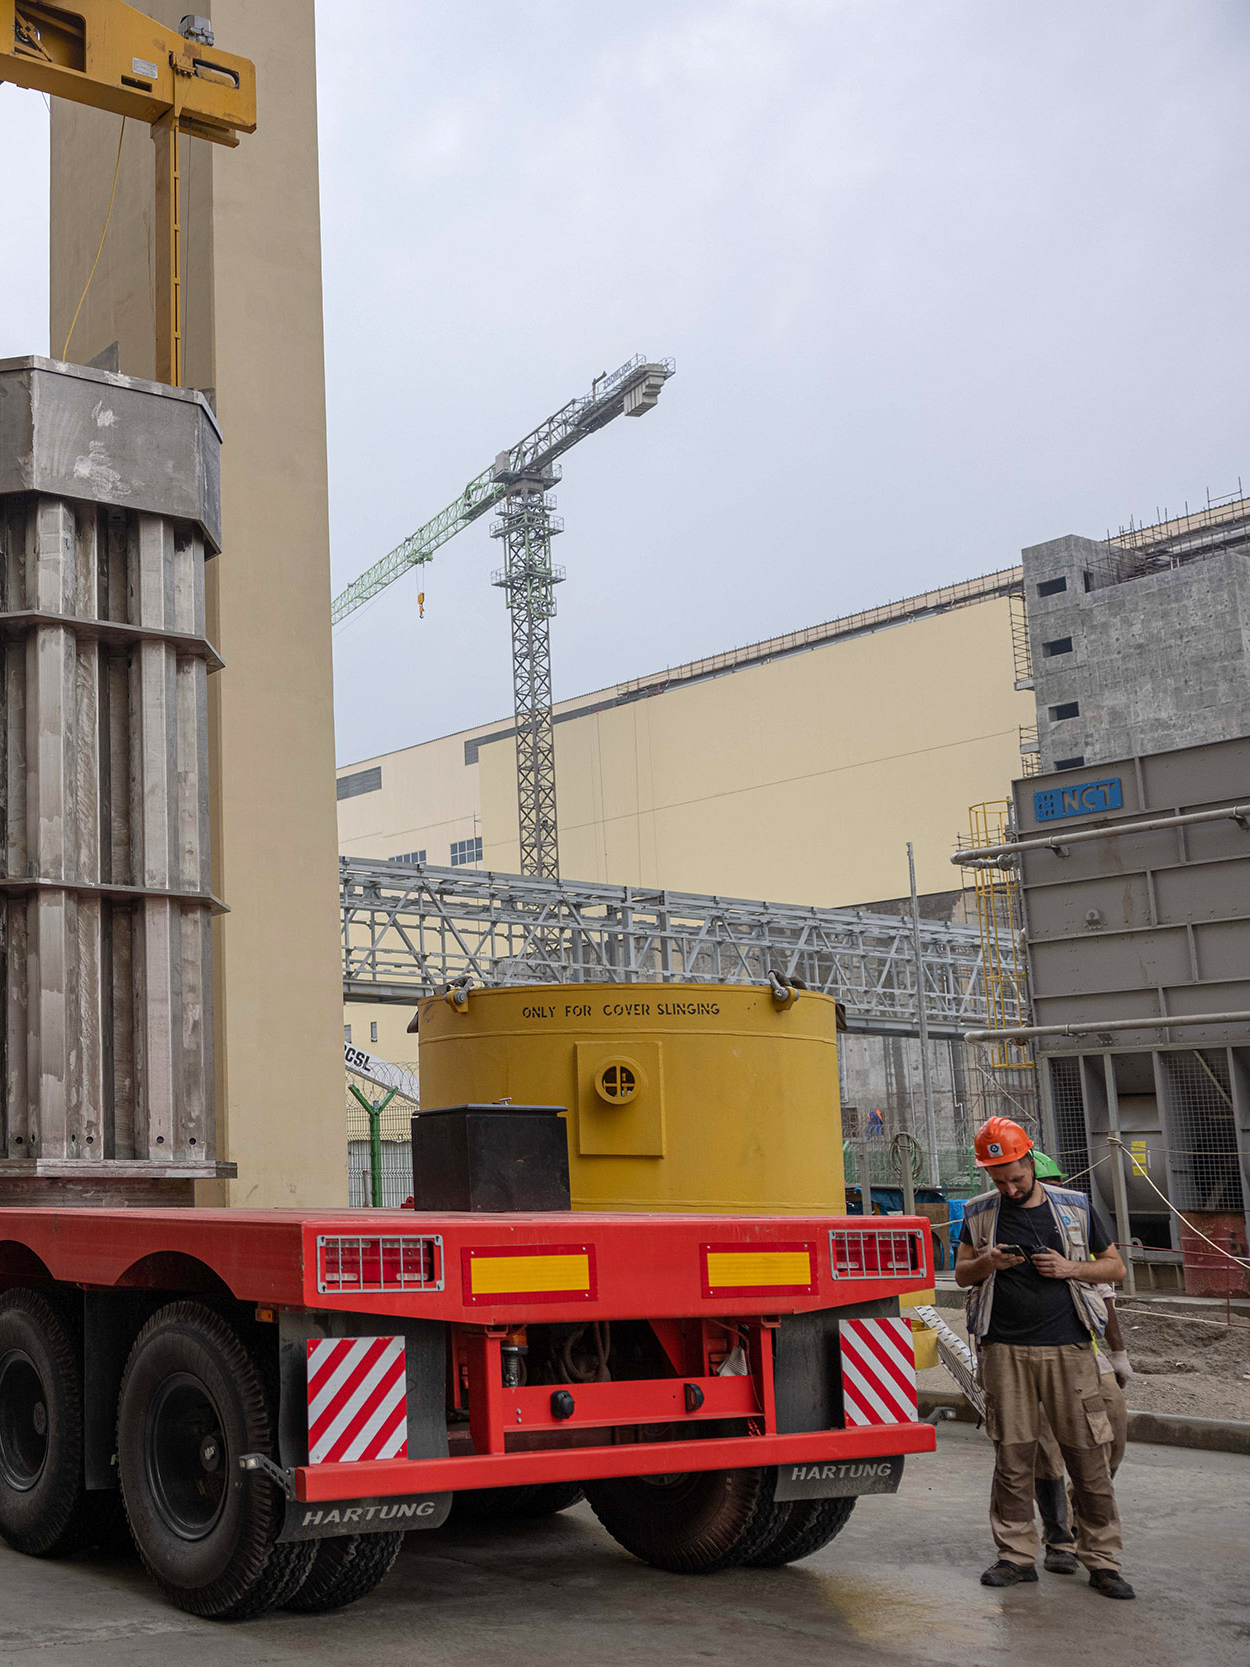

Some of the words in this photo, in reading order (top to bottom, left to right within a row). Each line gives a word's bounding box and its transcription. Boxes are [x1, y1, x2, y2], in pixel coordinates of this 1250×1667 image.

[1062, 782, 1116, 813] NCT
[522, 1006, 556, 1018] ONLY
[565, 1005, 592, 1017] FOR
[603, 1003, 650, 1016] COVER
[657, 1003, 720, 1016] SLINGING
[344, 1045, 370, 1072] CSL
[791, 1463, 892, 1481] HARTUNG
[302, 1502, 436, 1526] HARTUNG
